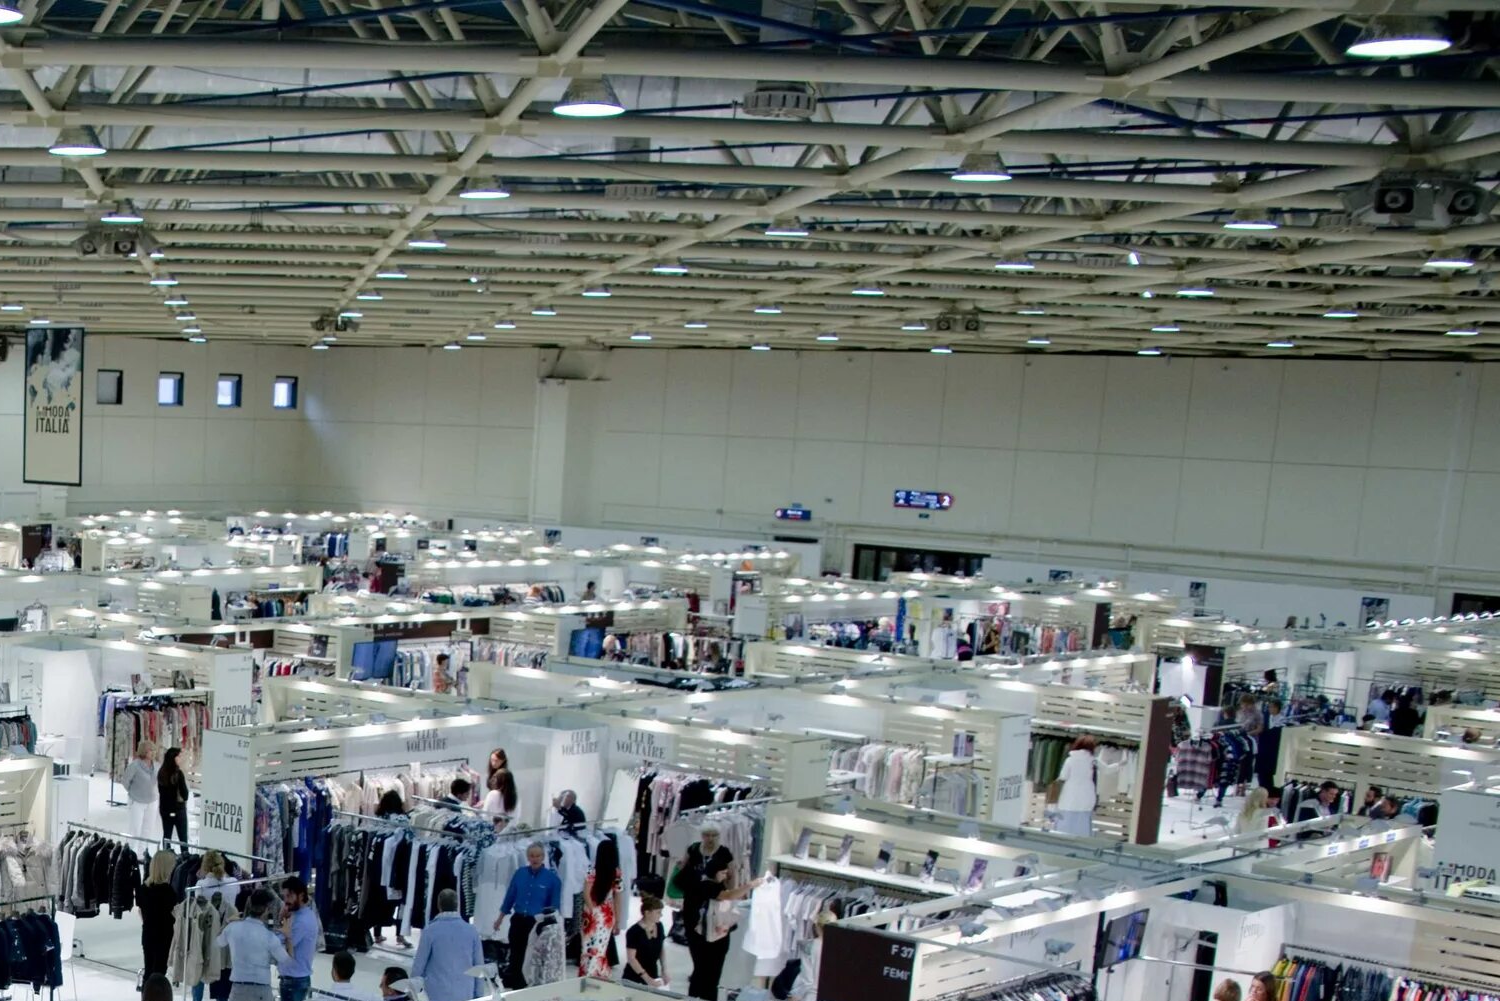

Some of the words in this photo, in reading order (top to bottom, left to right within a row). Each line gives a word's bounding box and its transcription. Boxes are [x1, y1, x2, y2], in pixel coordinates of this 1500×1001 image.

[44, 405, 70, 417] MODA
[35, 417, 69, 434] ITALIA
[216, 714, 246, 728] ITALIA
[405, 737, 449, 752] VOLTAIRE
[628, 731, 655, 745] CLUB
[562, 741, 598, 756] VOLTAIRE
[616, 740, 666, 760] VOLTAIRE
[215, 801, 243, 818] MODA
[204, 811, 243, 834] ITALIA
[1453, 864, 1497, 881] MODA
[890, 944, 899, 955] F
[901, 946, 914, 959] 37
